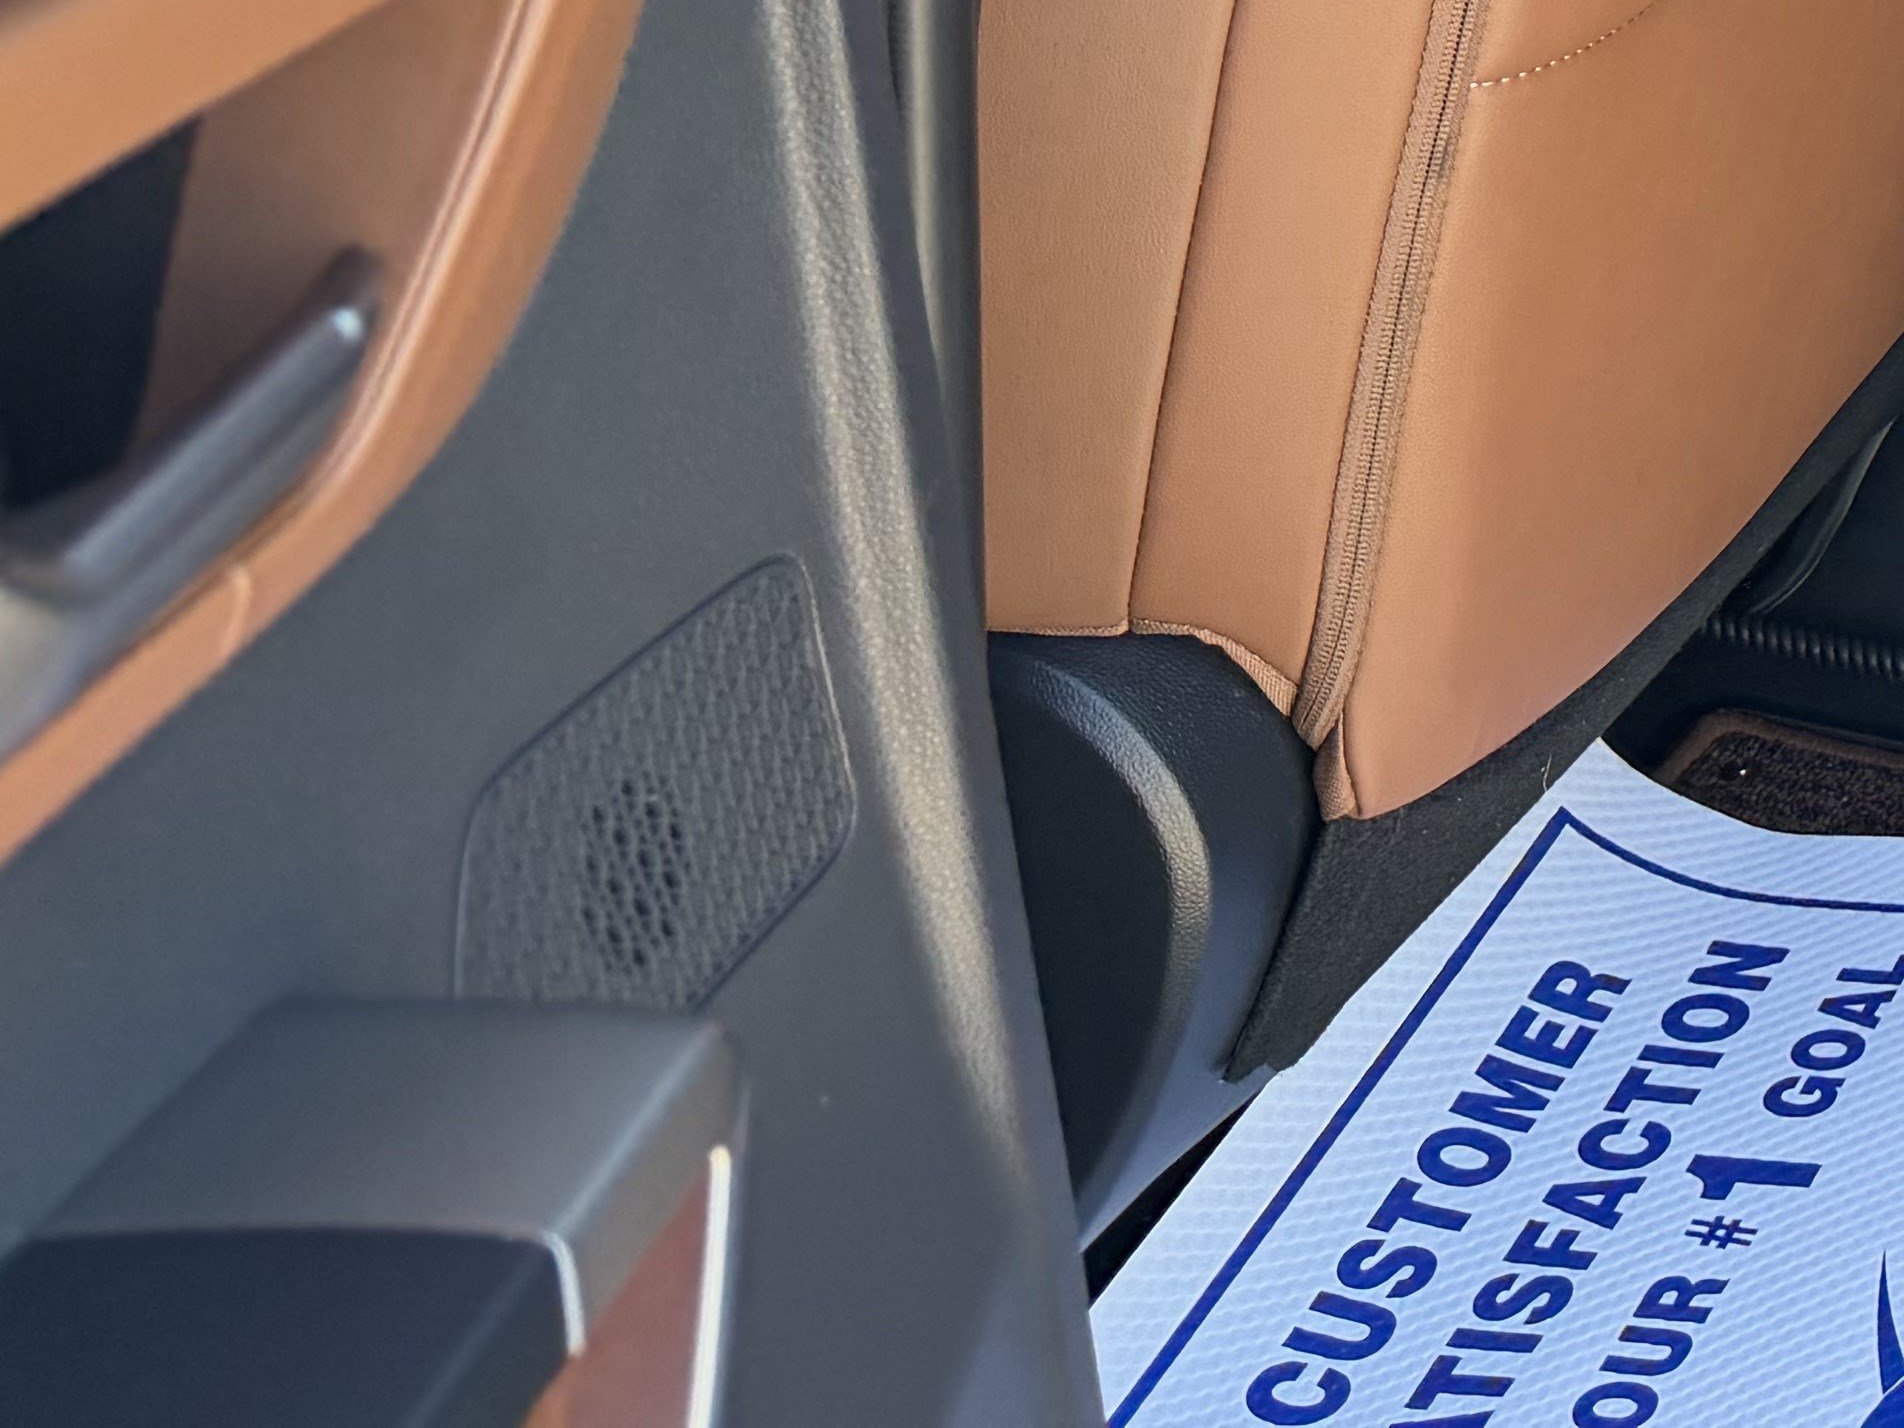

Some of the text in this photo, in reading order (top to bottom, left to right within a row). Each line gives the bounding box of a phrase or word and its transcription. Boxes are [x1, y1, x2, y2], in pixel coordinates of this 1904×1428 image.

[1245, 960, 1633, 1427] CUSTOMER
[1572, 1275, 1730, 1428] OUR
[1684, 1153, 1823, 1250] #1
